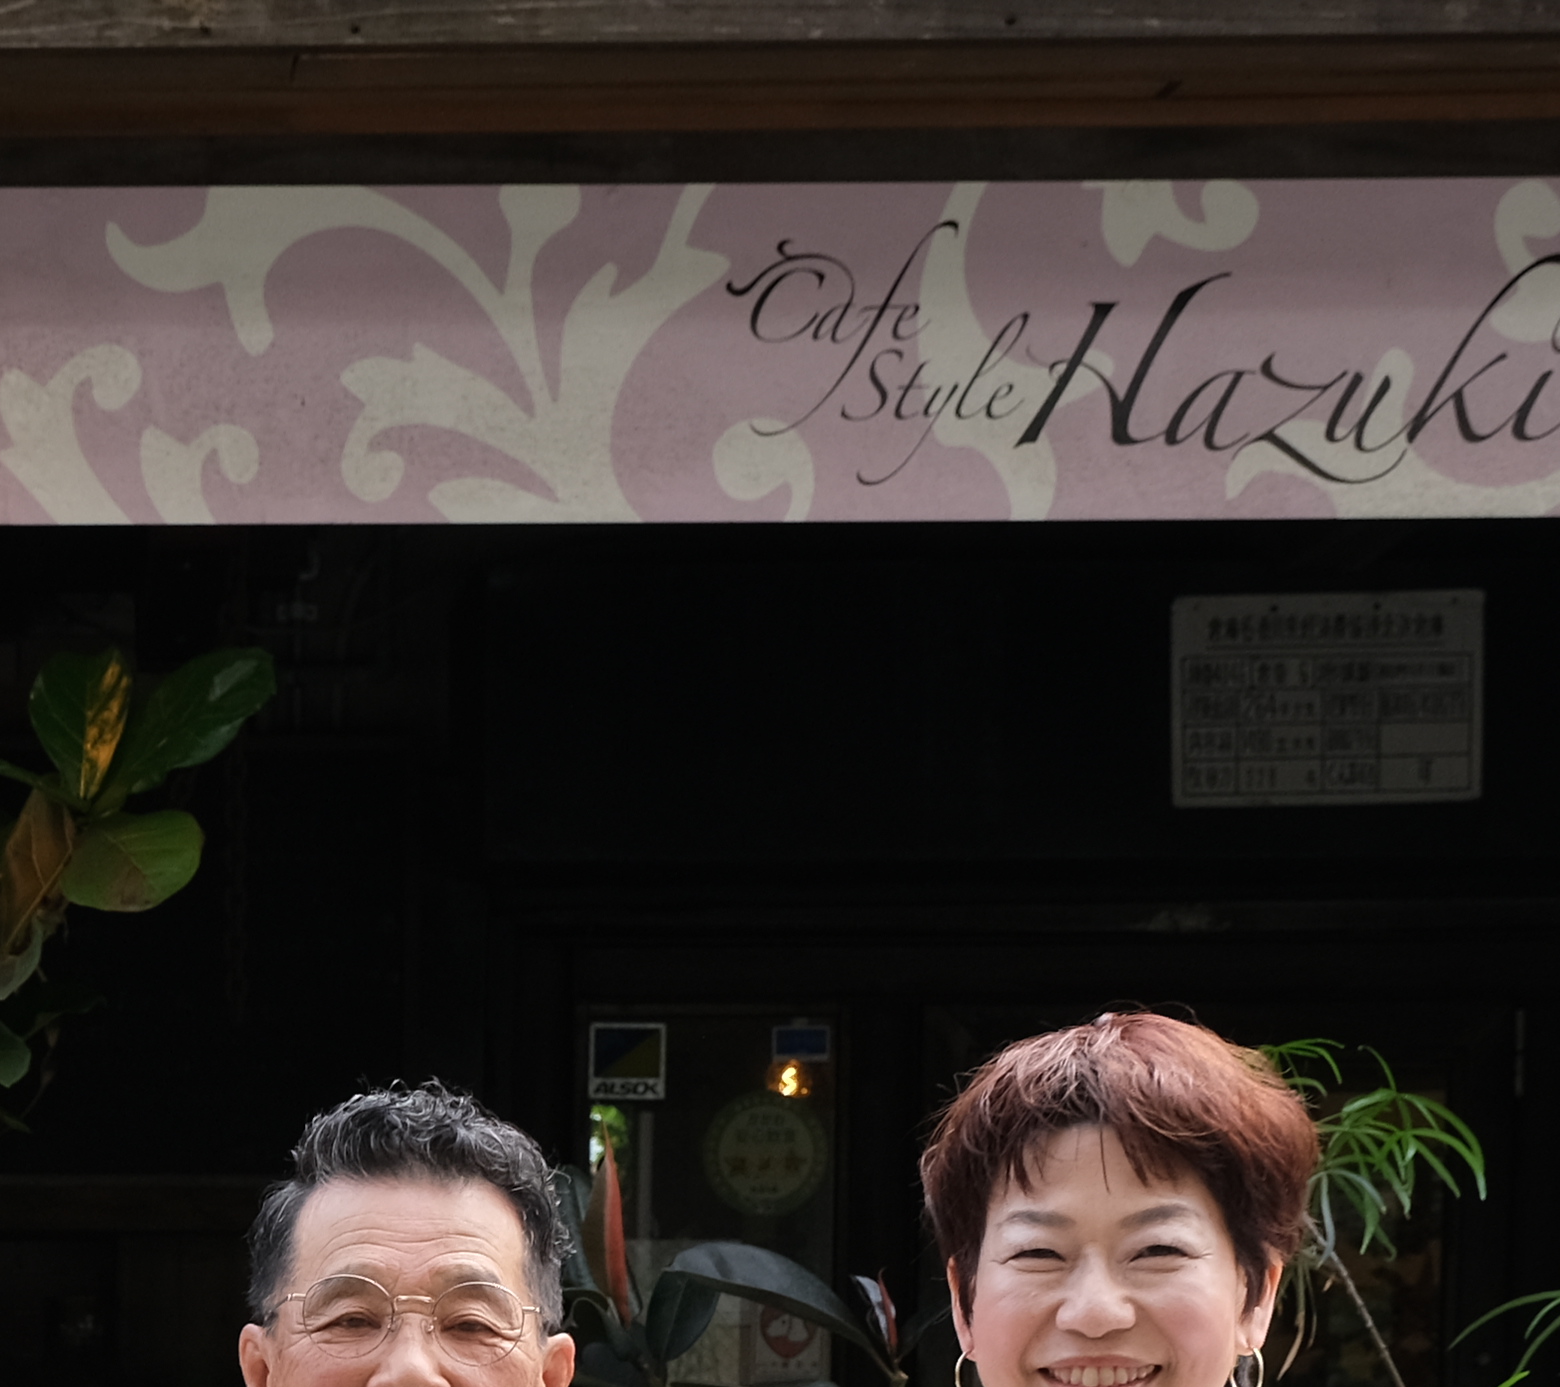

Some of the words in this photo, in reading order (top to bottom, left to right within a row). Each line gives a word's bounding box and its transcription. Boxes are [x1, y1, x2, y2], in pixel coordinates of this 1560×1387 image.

[726, 219, 960, 437] Cafe
[840, 313, 1030, 485] Style
[593, 1081, 660, 1097] ALSOK
